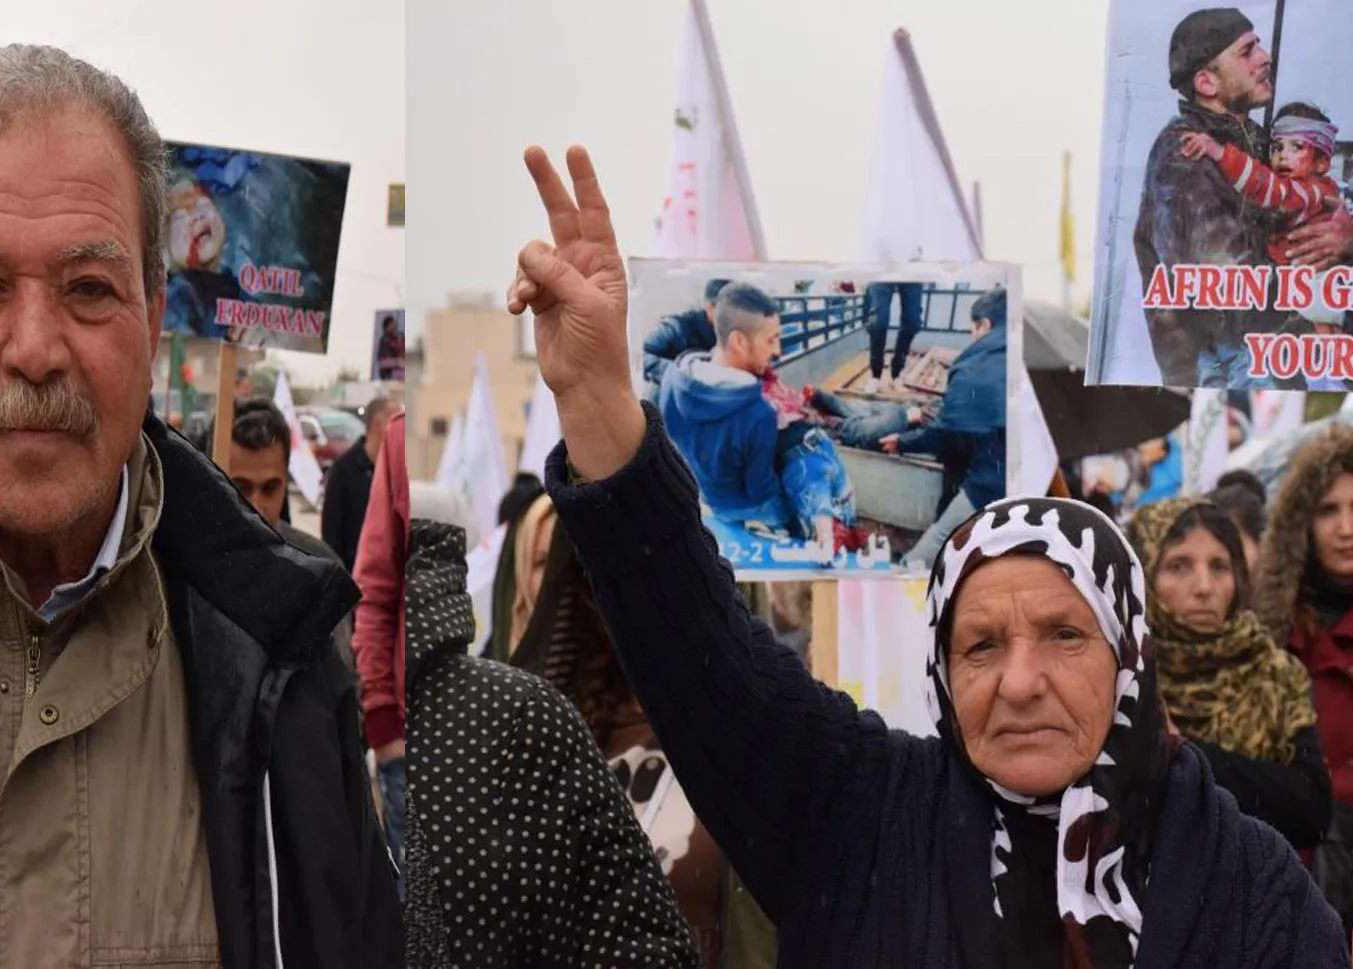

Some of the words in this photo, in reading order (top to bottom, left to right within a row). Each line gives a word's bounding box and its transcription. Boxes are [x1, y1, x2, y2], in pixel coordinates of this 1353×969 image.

[240, 263, 305, 297] QATIL
[1142, 264, 1270, 311] AFRIN
[1274, 265, 1315, 311] IS
[215, 297, 324, 337] ERDUXAN
[1245, 333, 1353, 379] YOUR
